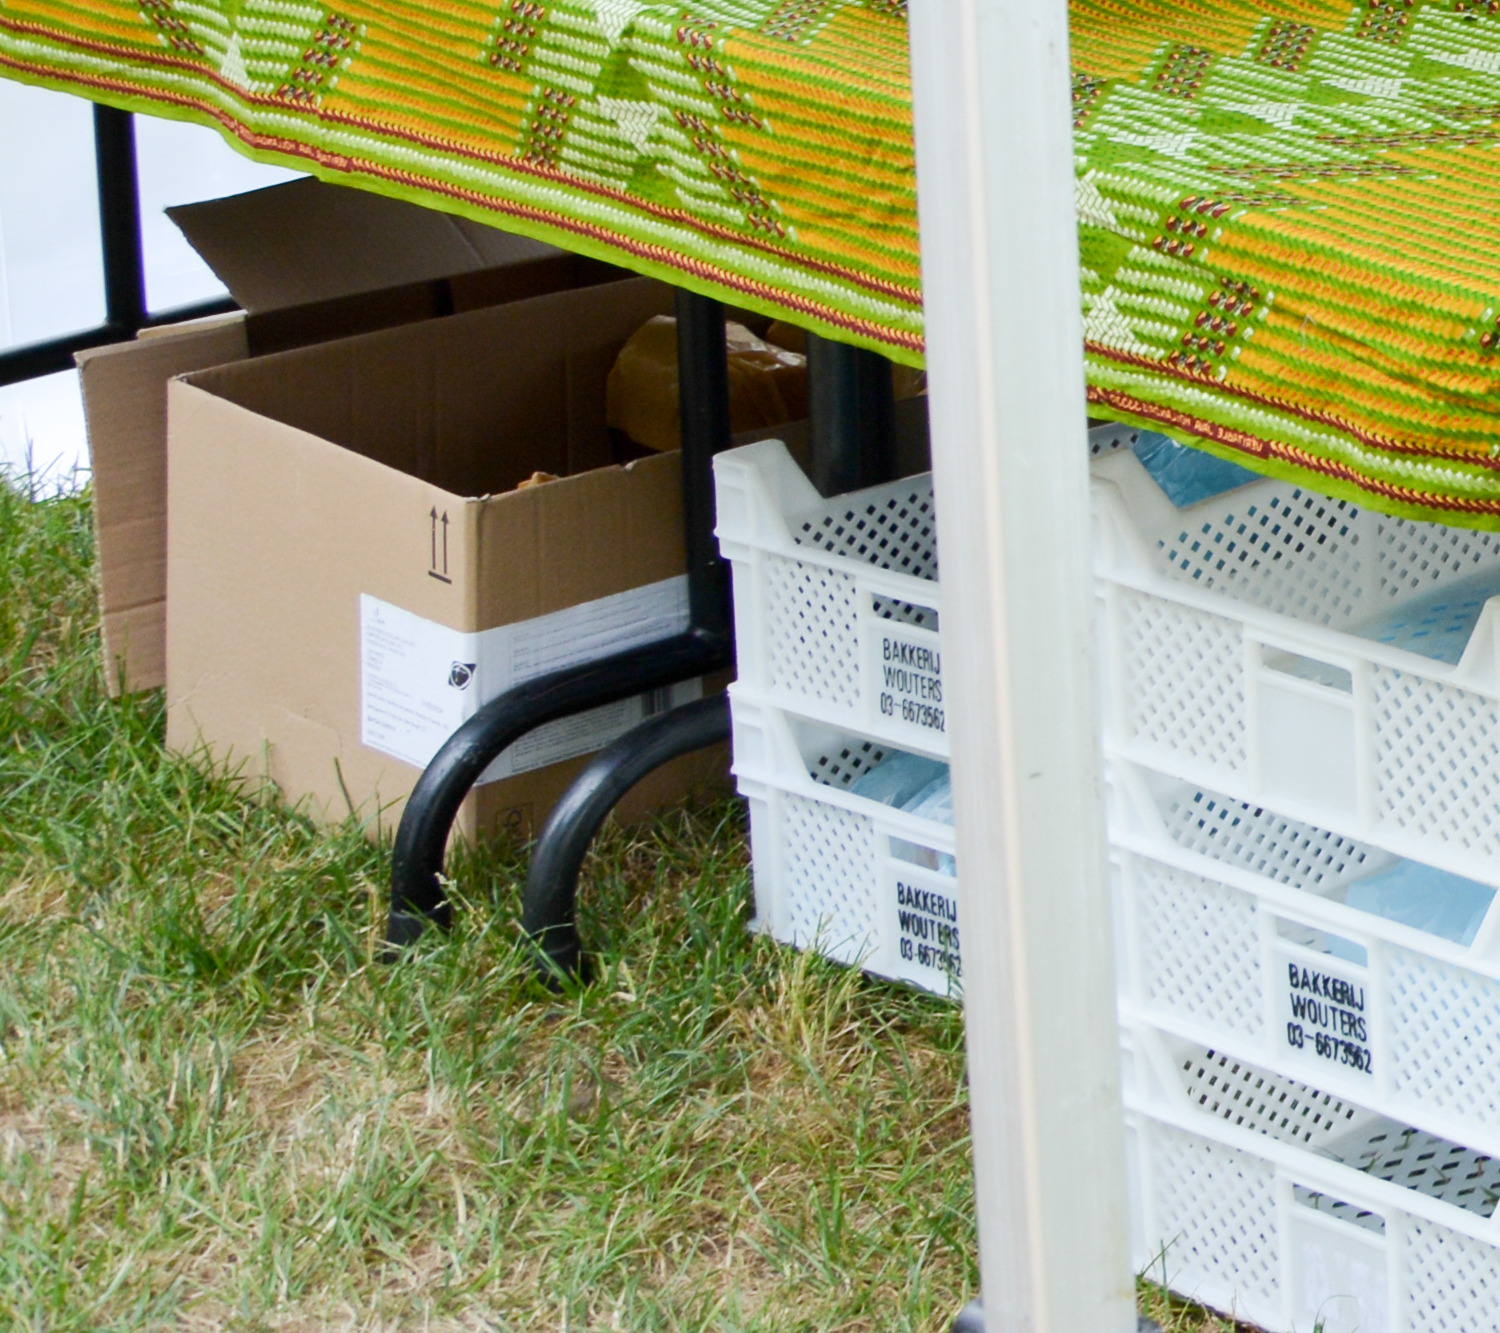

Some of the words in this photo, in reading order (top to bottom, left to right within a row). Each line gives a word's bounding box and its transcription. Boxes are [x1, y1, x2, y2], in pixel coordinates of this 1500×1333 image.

[883, 637, 940, 676] BAKKERIJ
[882, 664, 943, 703] WOUTERS
[880, 691, 946, 733] 03-6673562
[897, 881, 957, 923] BAKKERIJ
[898, 908, 961, 951] WOUTERS
[1288, 962, 1364, 1012] BAKKERIJ
[1290, 992, 1368, 1043] WOUTERS
[1286, 1021, 1374, 1075] 03-6673562
